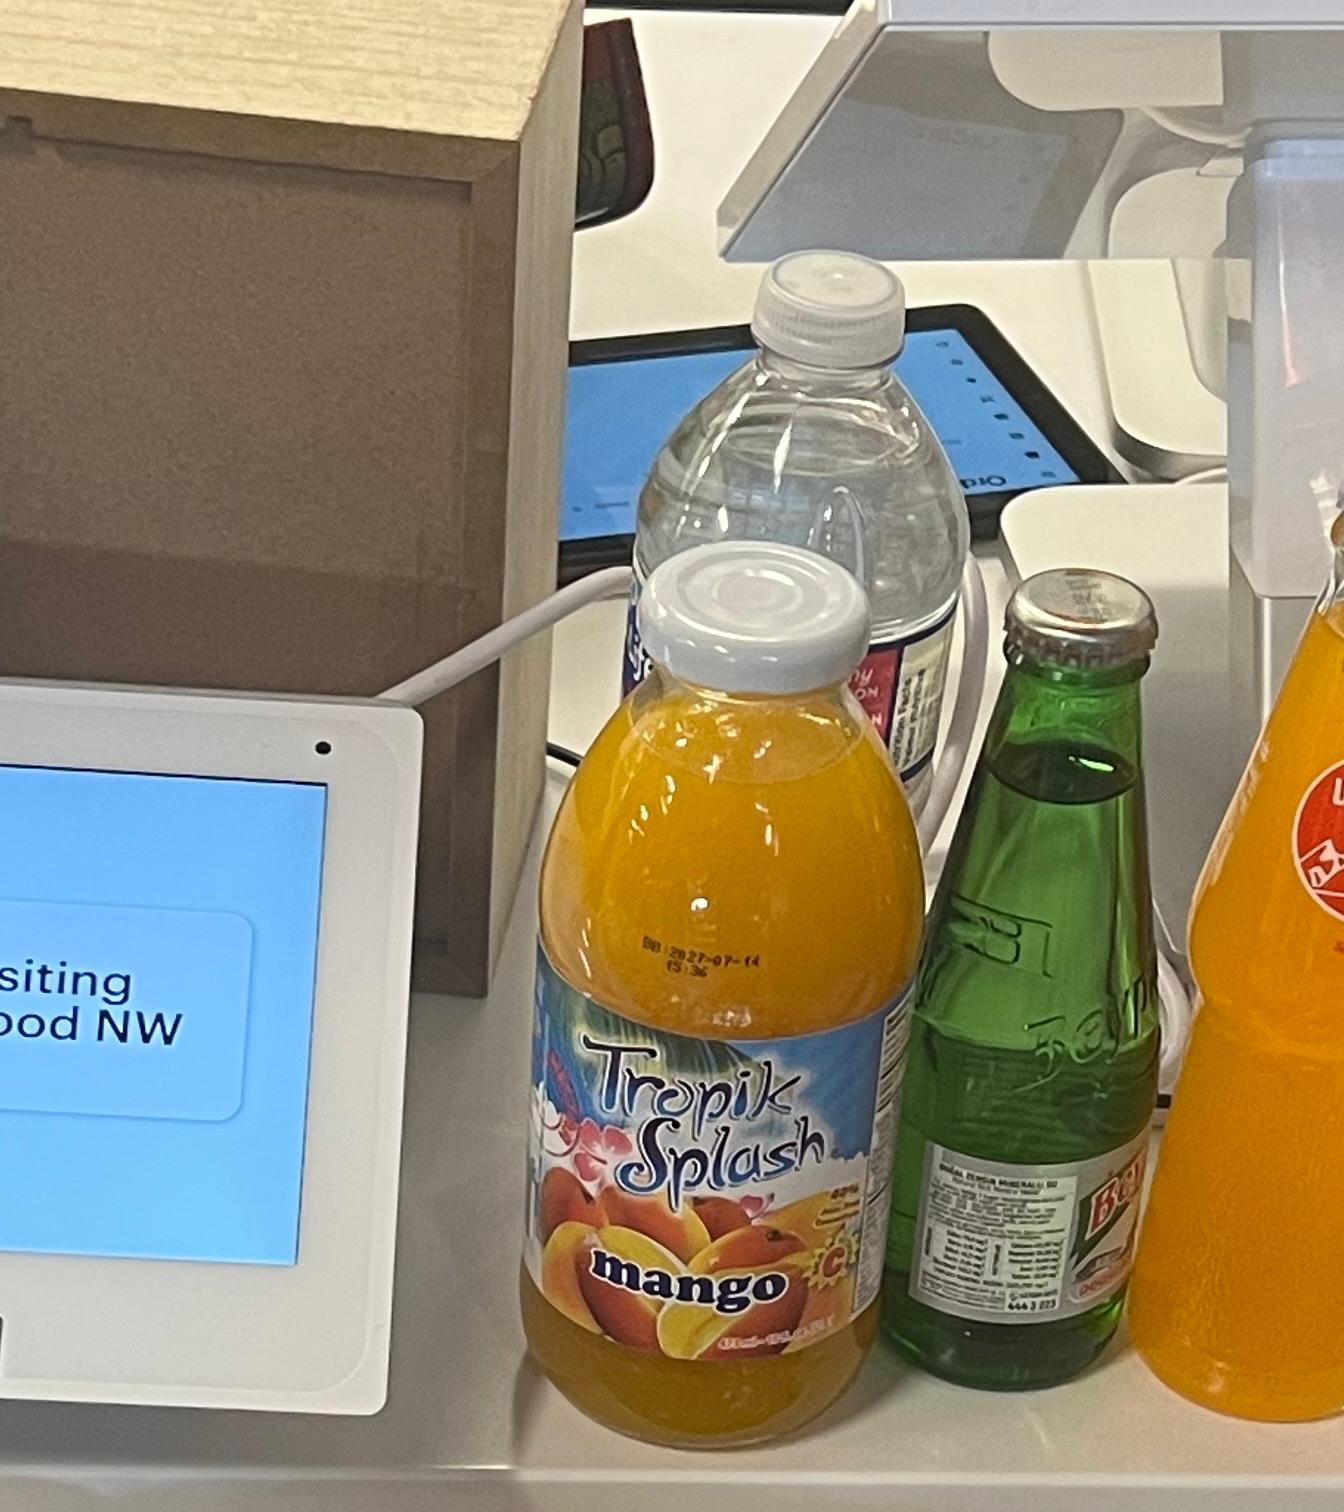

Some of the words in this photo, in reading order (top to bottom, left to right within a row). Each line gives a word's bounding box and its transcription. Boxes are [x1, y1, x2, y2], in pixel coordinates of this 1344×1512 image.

[96, 1006, 184, 1048] NW
[582, 1034, 802, 1142] Tropik
[614, 1116, 826, 1213] Splash
[591, 1248, 788, 1315] mango
